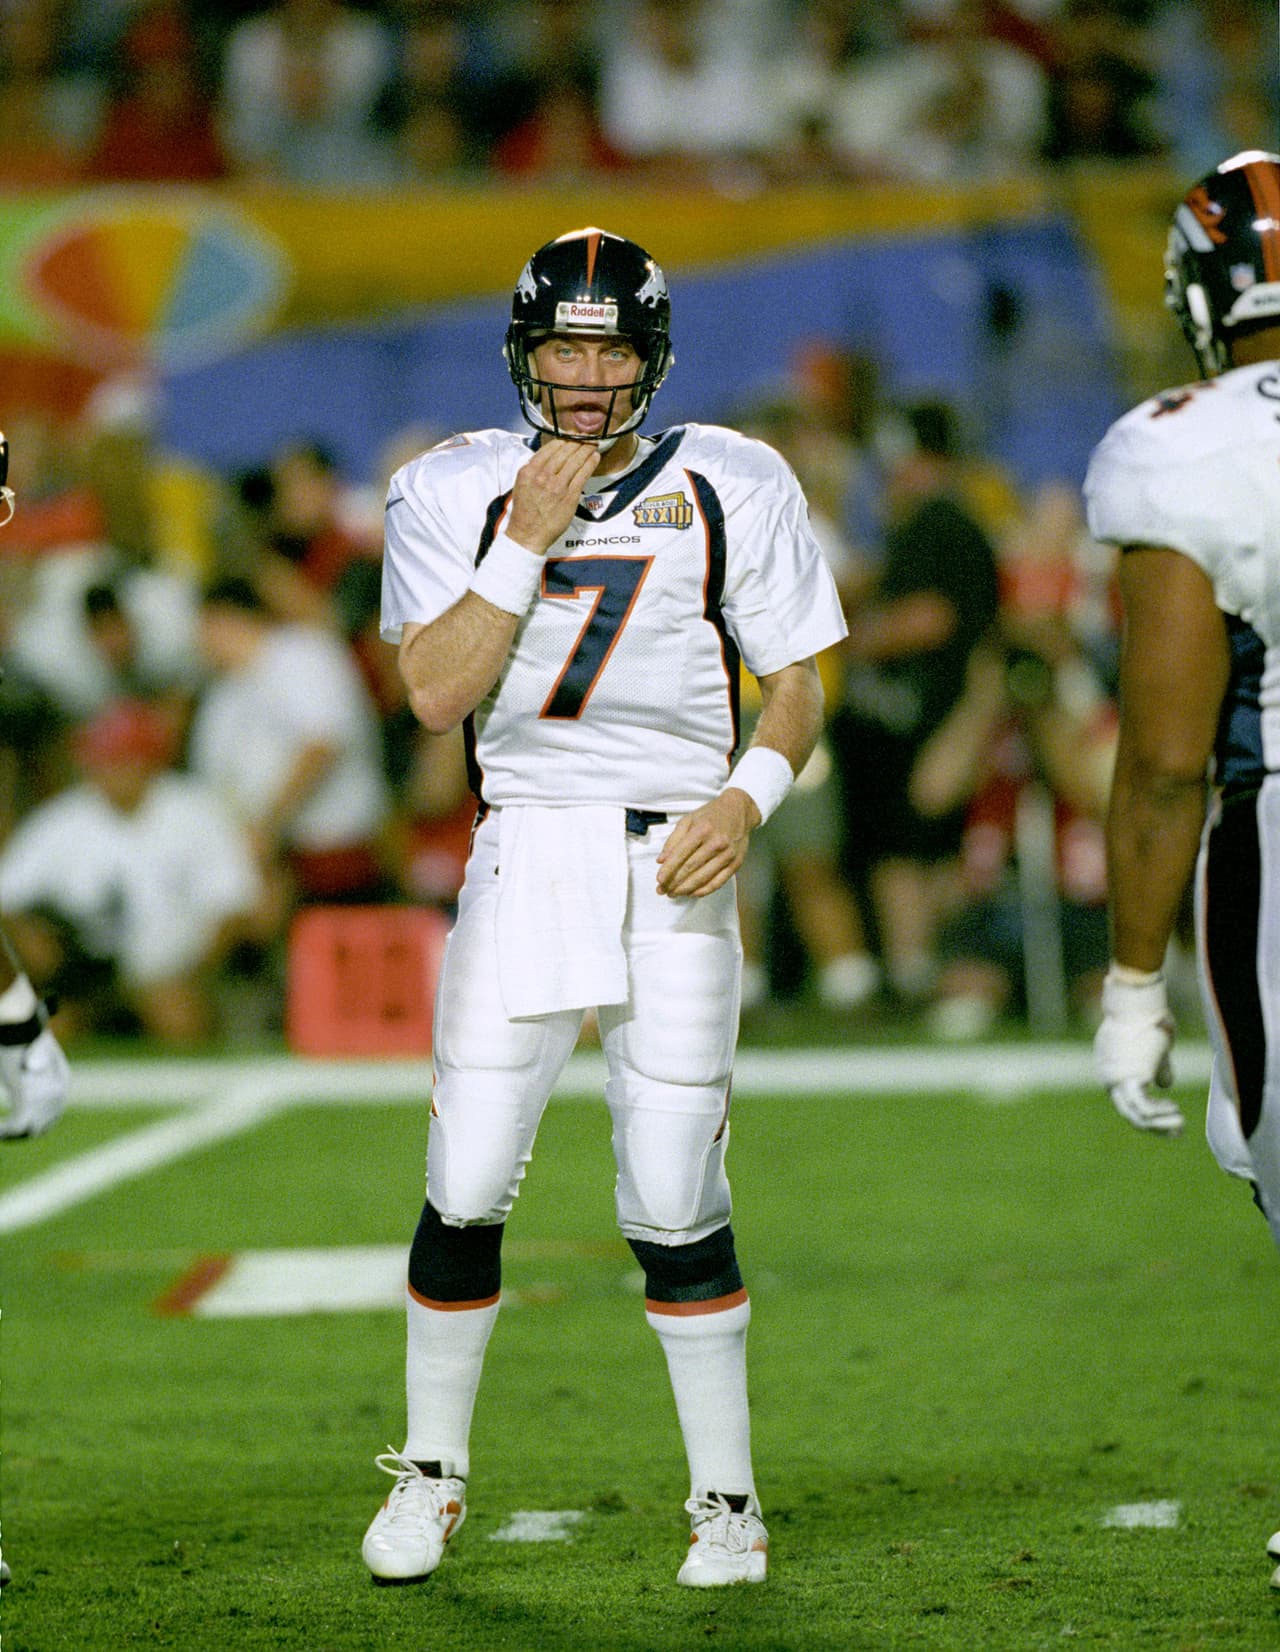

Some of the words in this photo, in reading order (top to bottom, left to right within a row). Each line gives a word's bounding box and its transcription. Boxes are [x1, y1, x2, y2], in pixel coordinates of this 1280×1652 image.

[570, 305, 605, 318] Riddell
[565, 536, 641, 548] BRONCOS
[539, 555, 656, 720] 7
